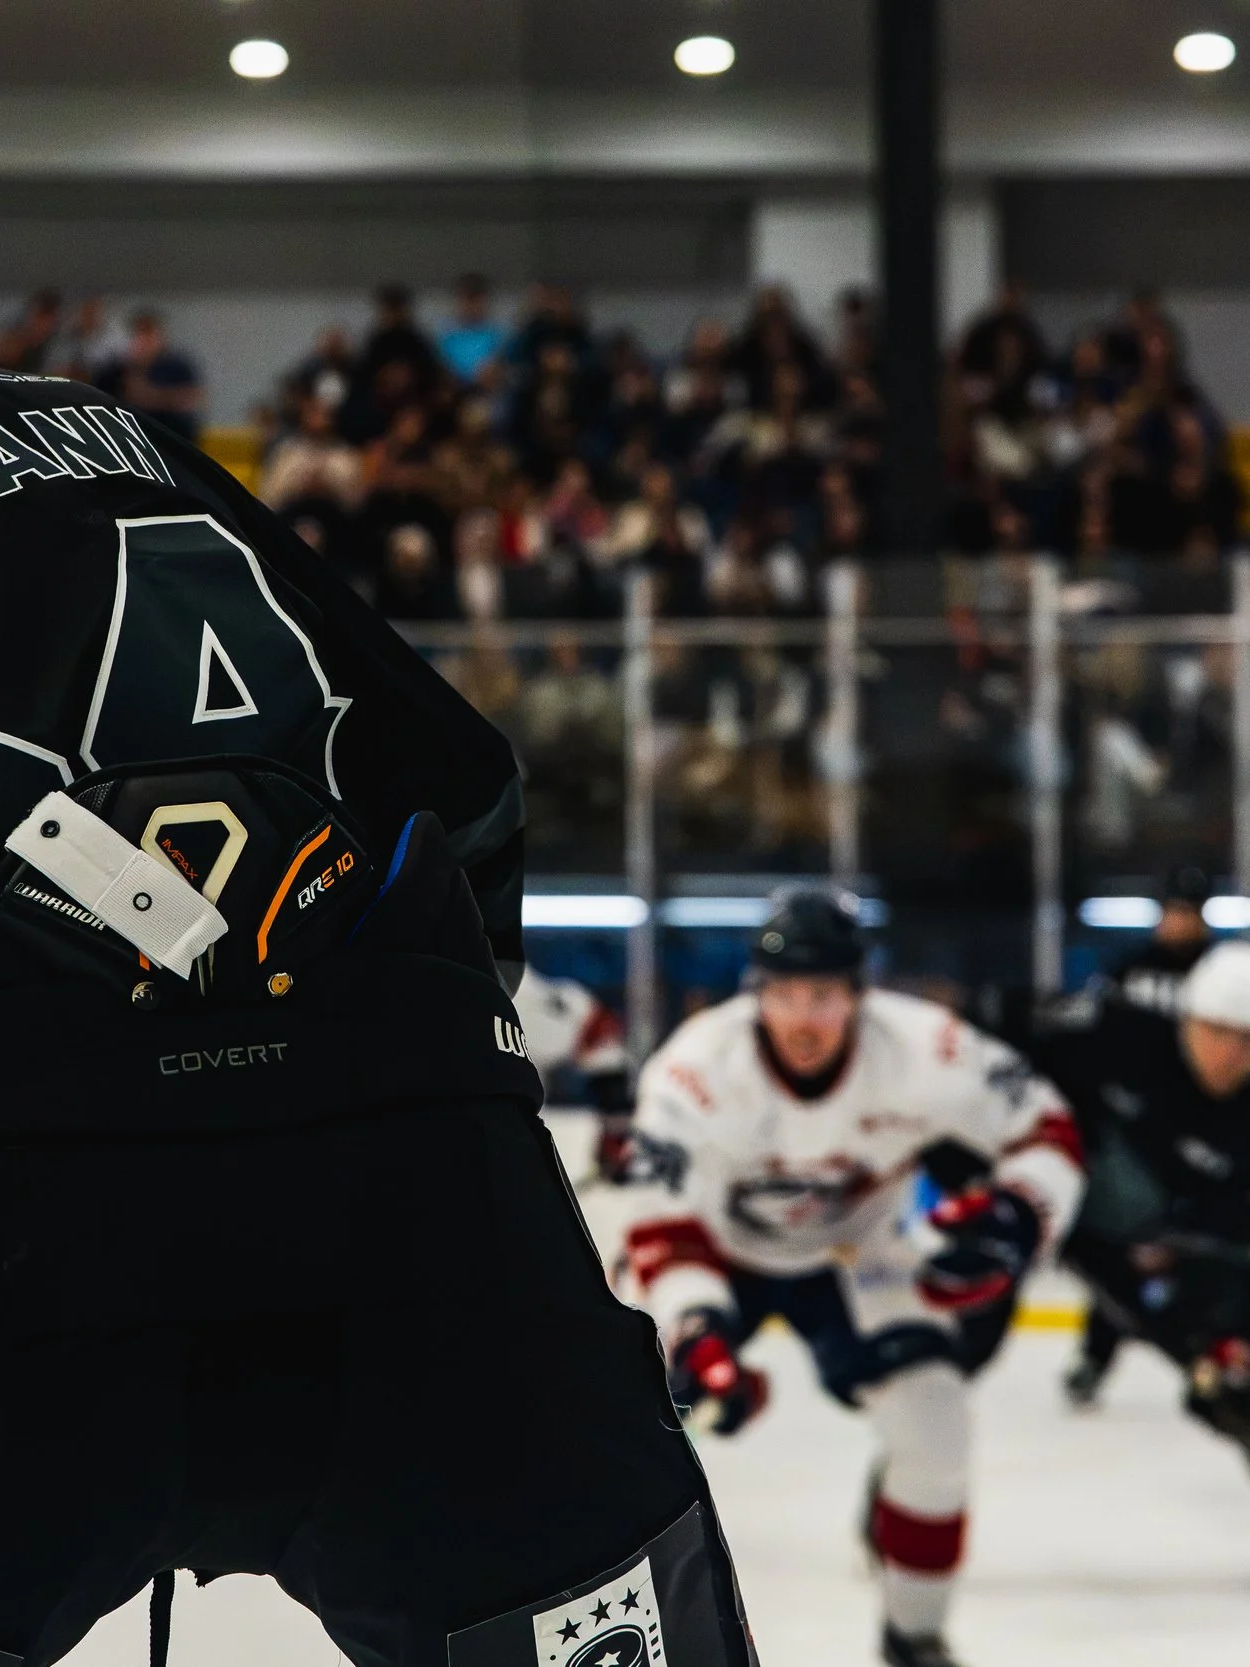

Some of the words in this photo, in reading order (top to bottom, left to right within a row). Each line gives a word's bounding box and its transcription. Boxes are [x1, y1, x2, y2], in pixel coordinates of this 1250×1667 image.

[161, 838, 199, 881] IMPAX
[297, 866, 335, 910] QRE
[335, 850, 355, 876] 10
[13, 881, 106, 932] WARRIOR
[158, 1042, 289, 1075] COVERT
